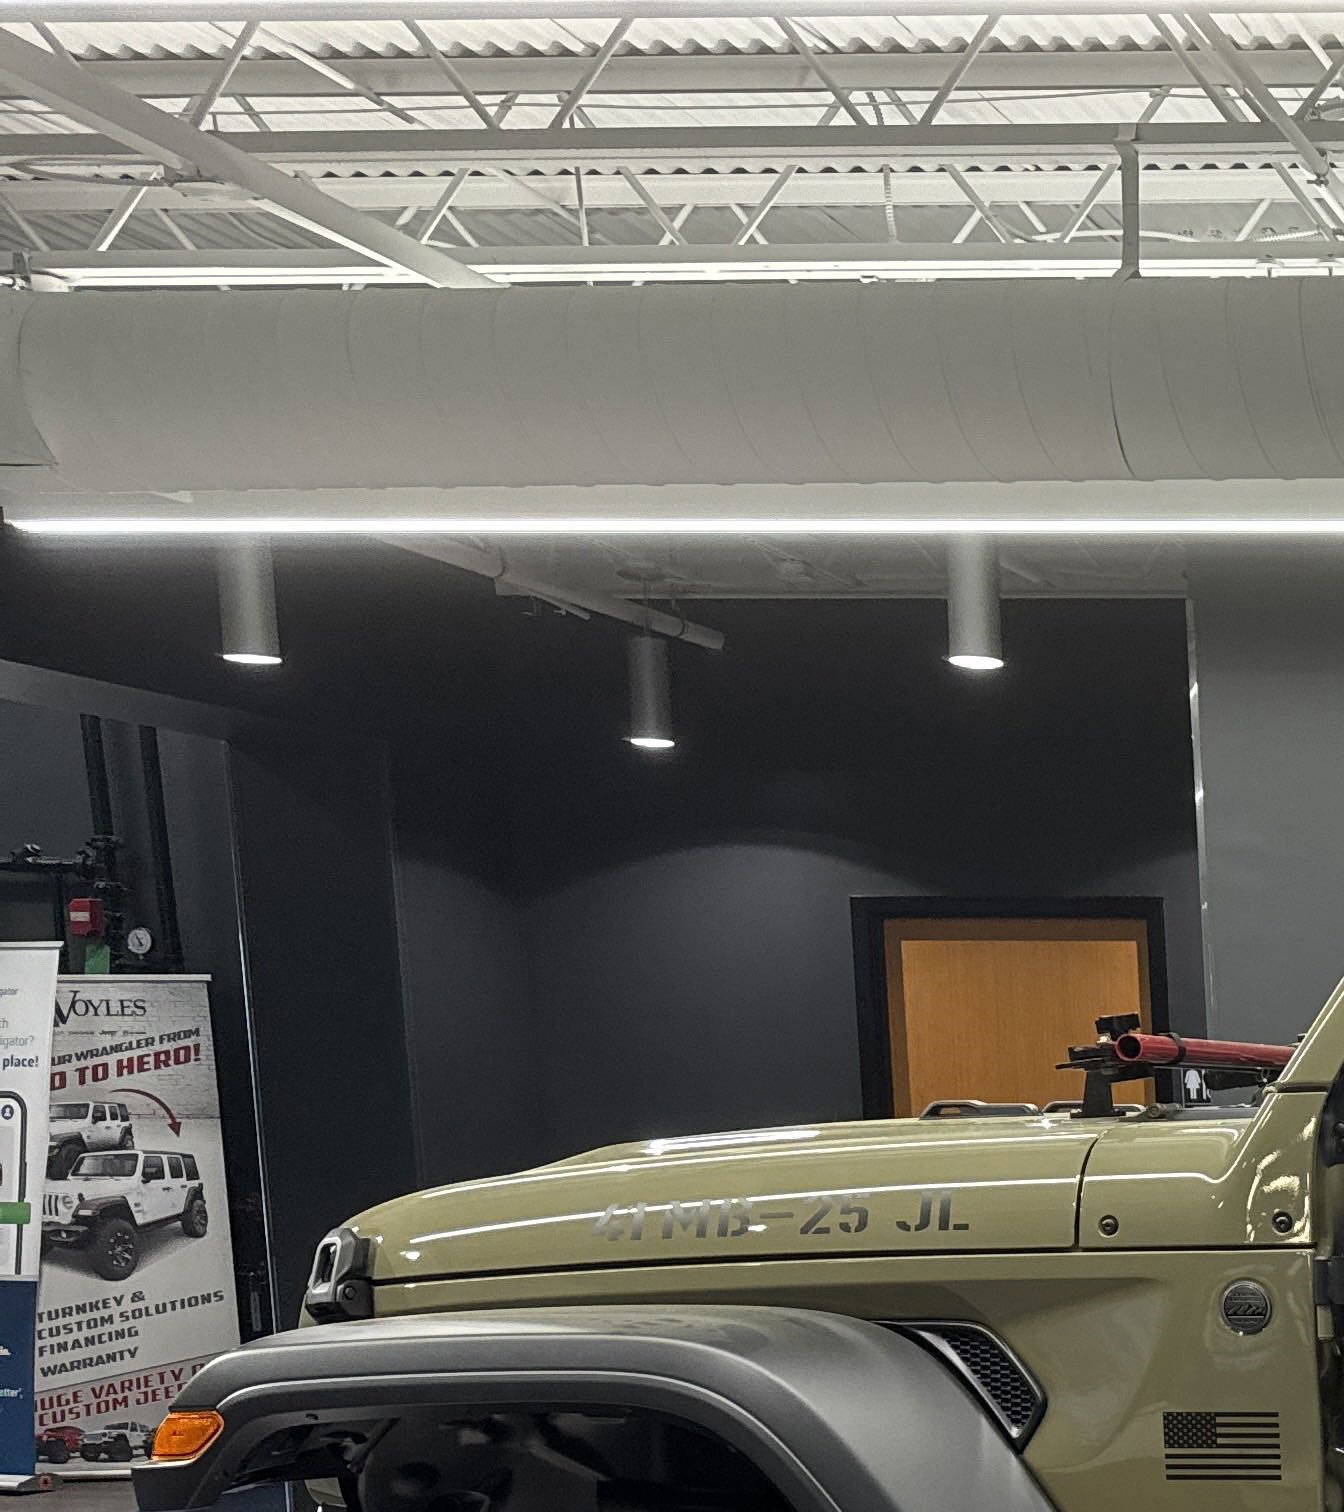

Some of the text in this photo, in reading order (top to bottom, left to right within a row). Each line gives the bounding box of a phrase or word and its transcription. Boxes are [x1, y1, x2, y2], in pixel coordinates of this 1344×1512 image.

[75, 1036, 155, 1062] WRANGLER
[159, 1028, 200, 1045] FROM
[2, 1054, 38, 1070] place!
[74, 1062, 109, 1086] TO
[116, 1043, 201, 1079] HERO!
[896, 1190, 969, 1232] JL
[37, 1290, 146, 1323] TURNKEY &
[37, 1290, 224, 1340] CUSTOM SOLUTIONS
[38, 1326, 139, 1357] FINANCING
[40, 1346, 139, 1377] WARRANTY
[91, 1367, 184, 1398] VARIETY
[38, 1396, 129, 1426] CUSTOM
